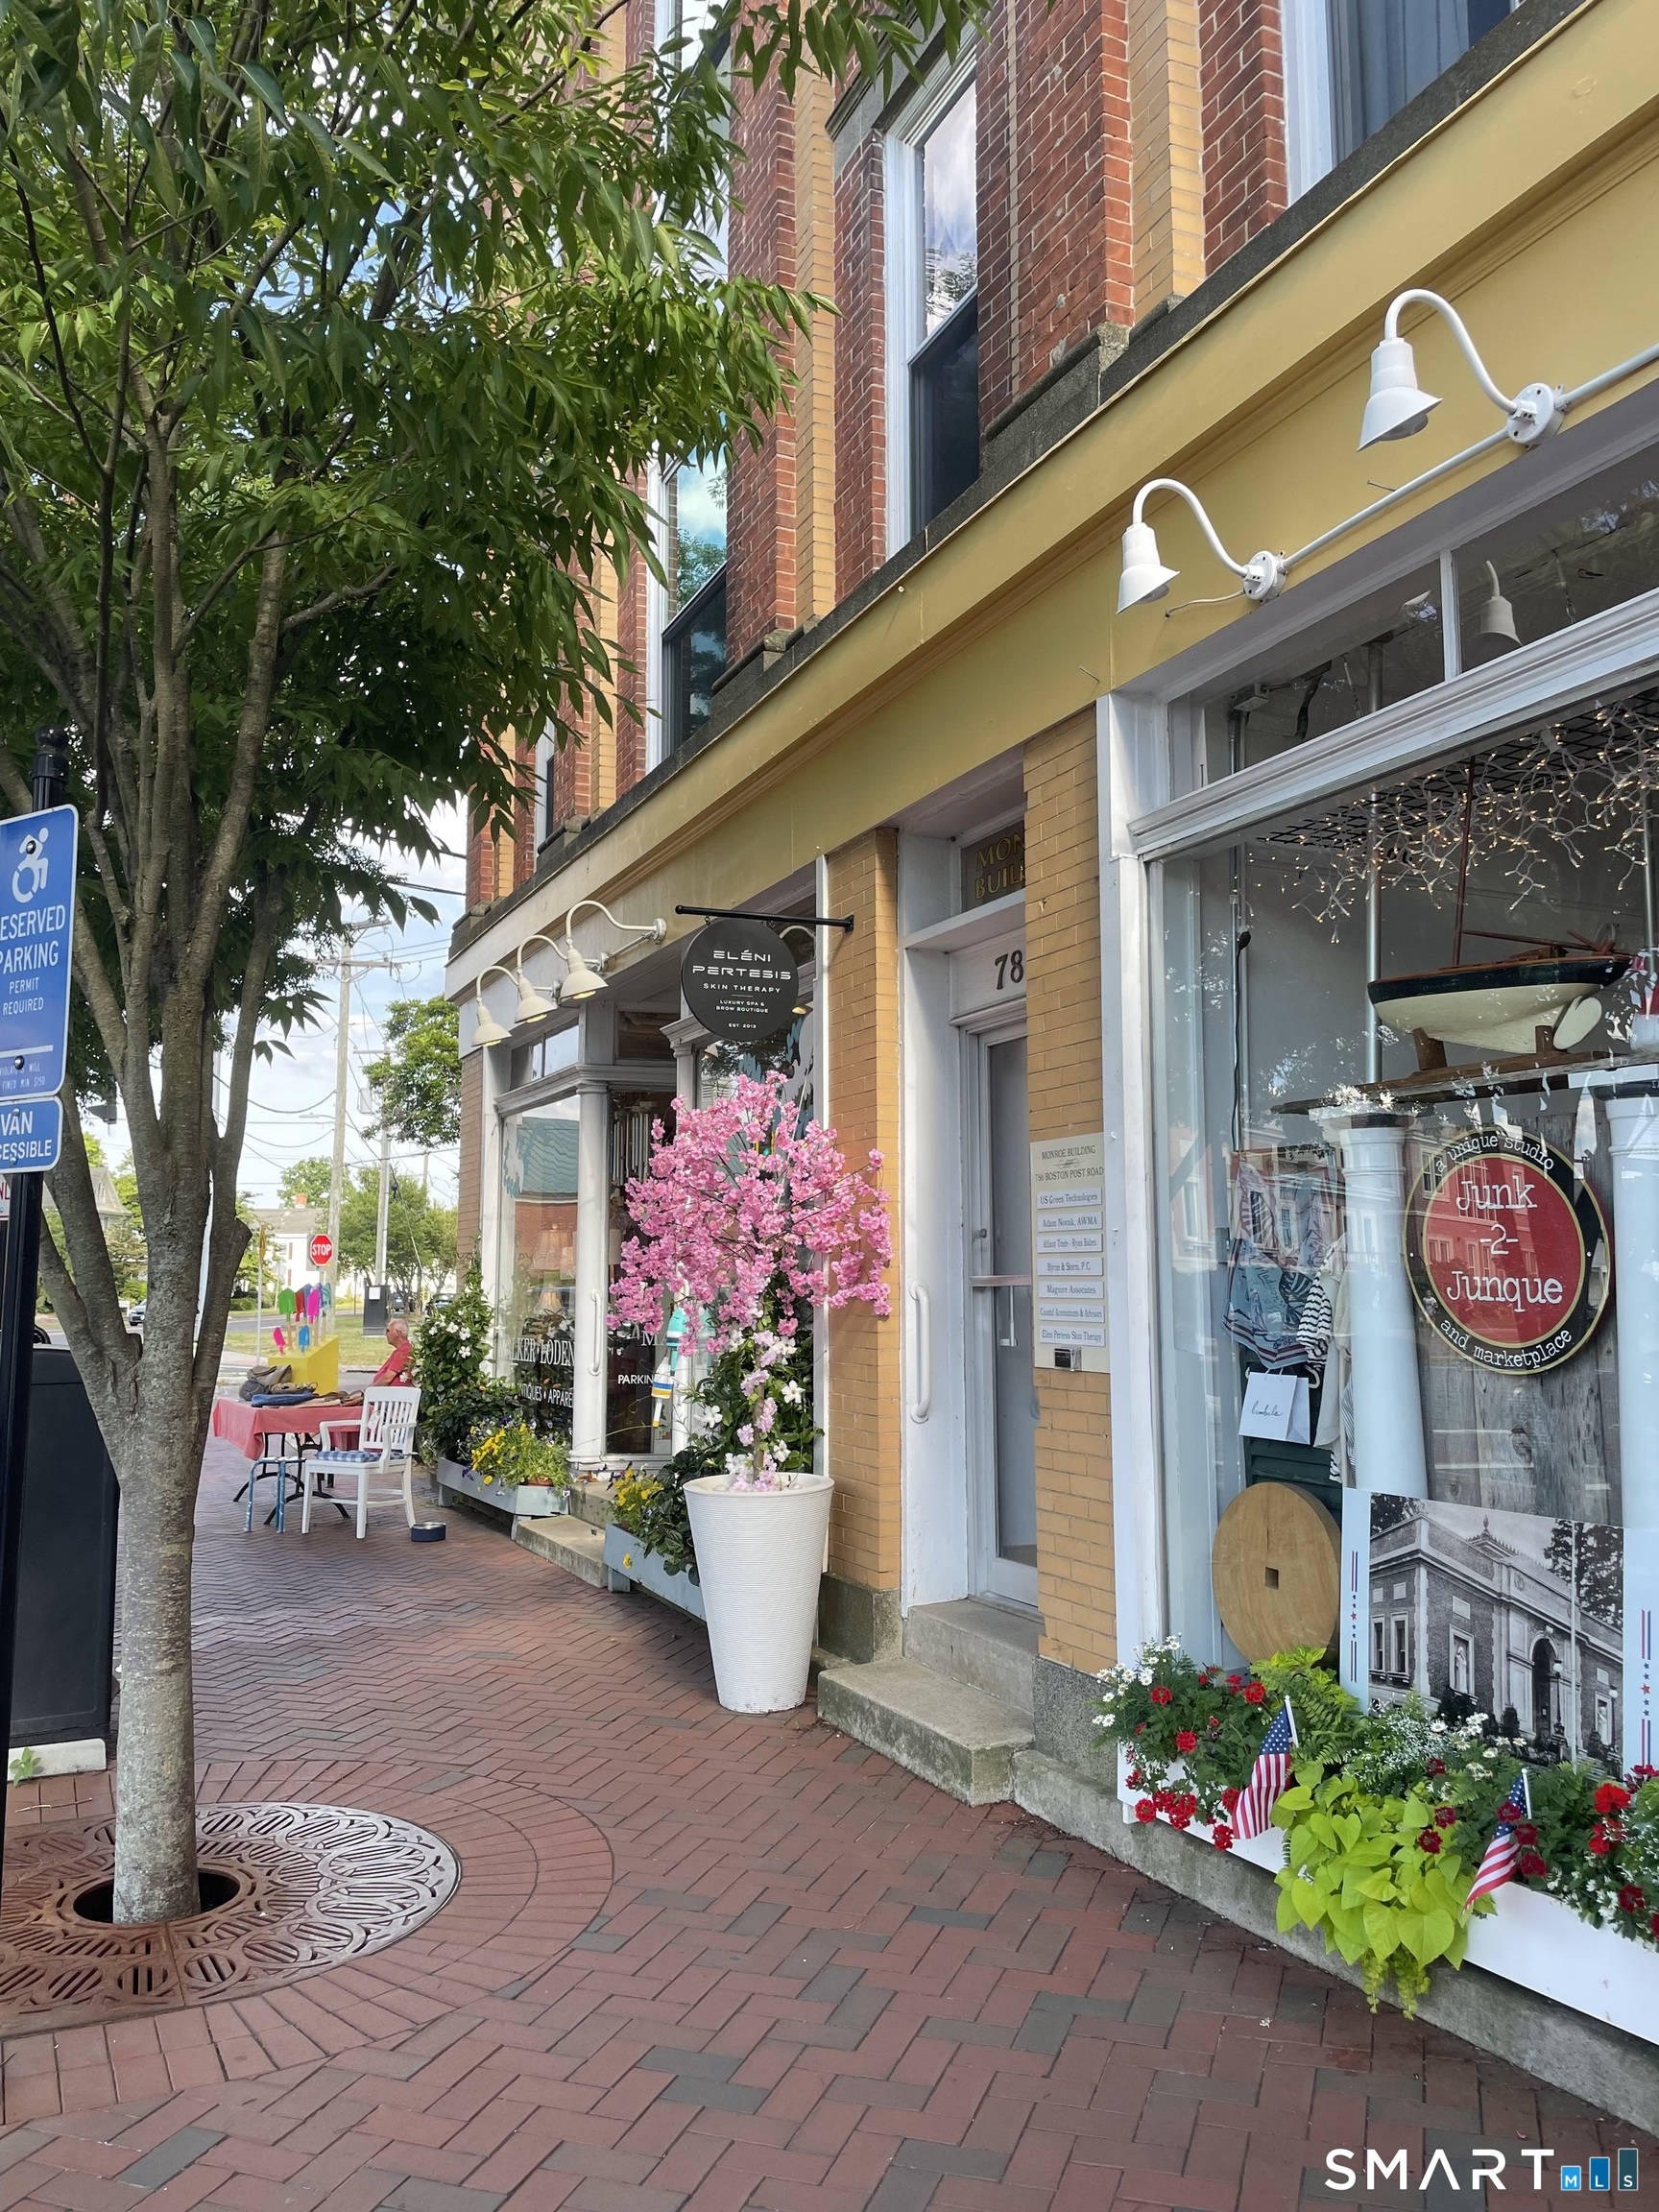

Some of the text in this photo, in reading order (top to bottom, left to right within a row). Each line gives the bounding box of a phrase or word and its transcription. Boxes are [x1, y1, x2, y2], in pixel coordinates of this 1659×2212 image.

[713, 950, 771, 962] ELÉNI
[692, 965, 791, 980] PERTESIS
[995, 950, 1024, 990] 78
[10, 977, 39, 995] PERMIT
[733, 984, 781, 994] THERAPY
[3, 998, 43, 1016] REQUIRED
[1, 1111, 34, 1137] VAN
[1041, 1145, 1095, 1160] MONROE BUILDING
[1435, 1134, 1554, 1172] a unique studio
[1046, 1170, 1069, 1181] BOSTON
[1070, 1168, 1086, 1179] POST
[1087, 1166, 1103, 1176] ROAD
[1040, 1193, 1097, 1204] US Green Technologies
[1455, 1175, 1538, 1211] Junk
[312, 1243, 331, 1256] STOP
[1061, 1262, 1065, 1271] &
[1046, 1285, 1095, 1295] Maguire Associates
[1446, 1270, 1563, 1312] Junque
[1071, 1331, 1082, 1340] Skin
[1083, 1332, 1101, 1342] Therapy
[1440, 1319, 1572, 1368] and marketplace
